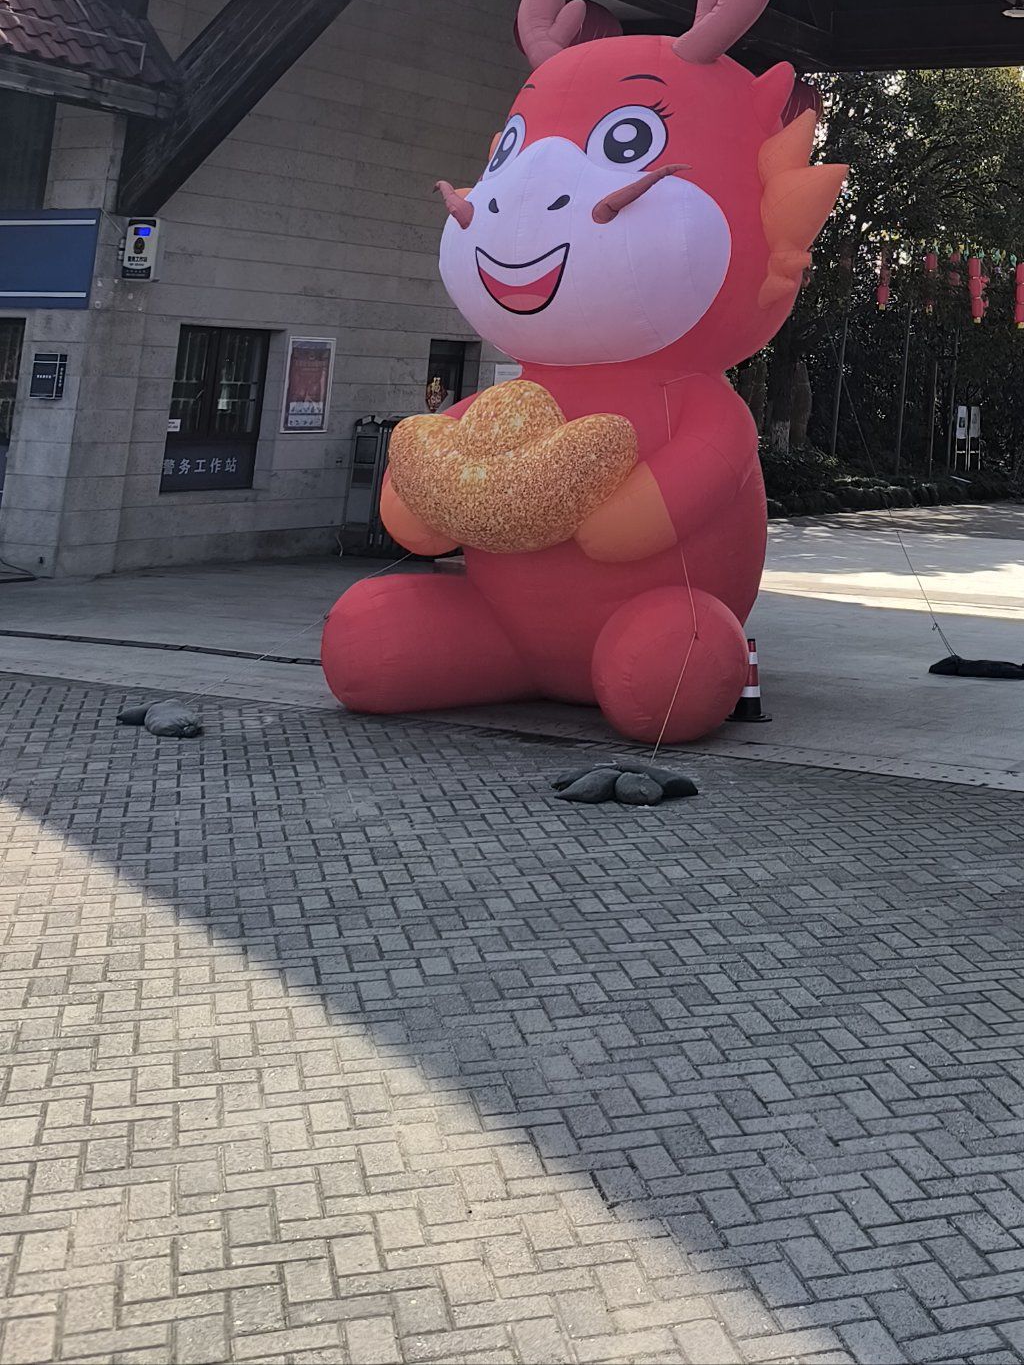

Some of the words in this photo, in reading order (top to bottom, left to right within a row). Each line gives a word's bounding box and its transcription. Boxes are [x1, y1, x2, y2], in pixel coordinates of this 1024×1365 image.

[163, 457, 238, 475] 警务工作站
